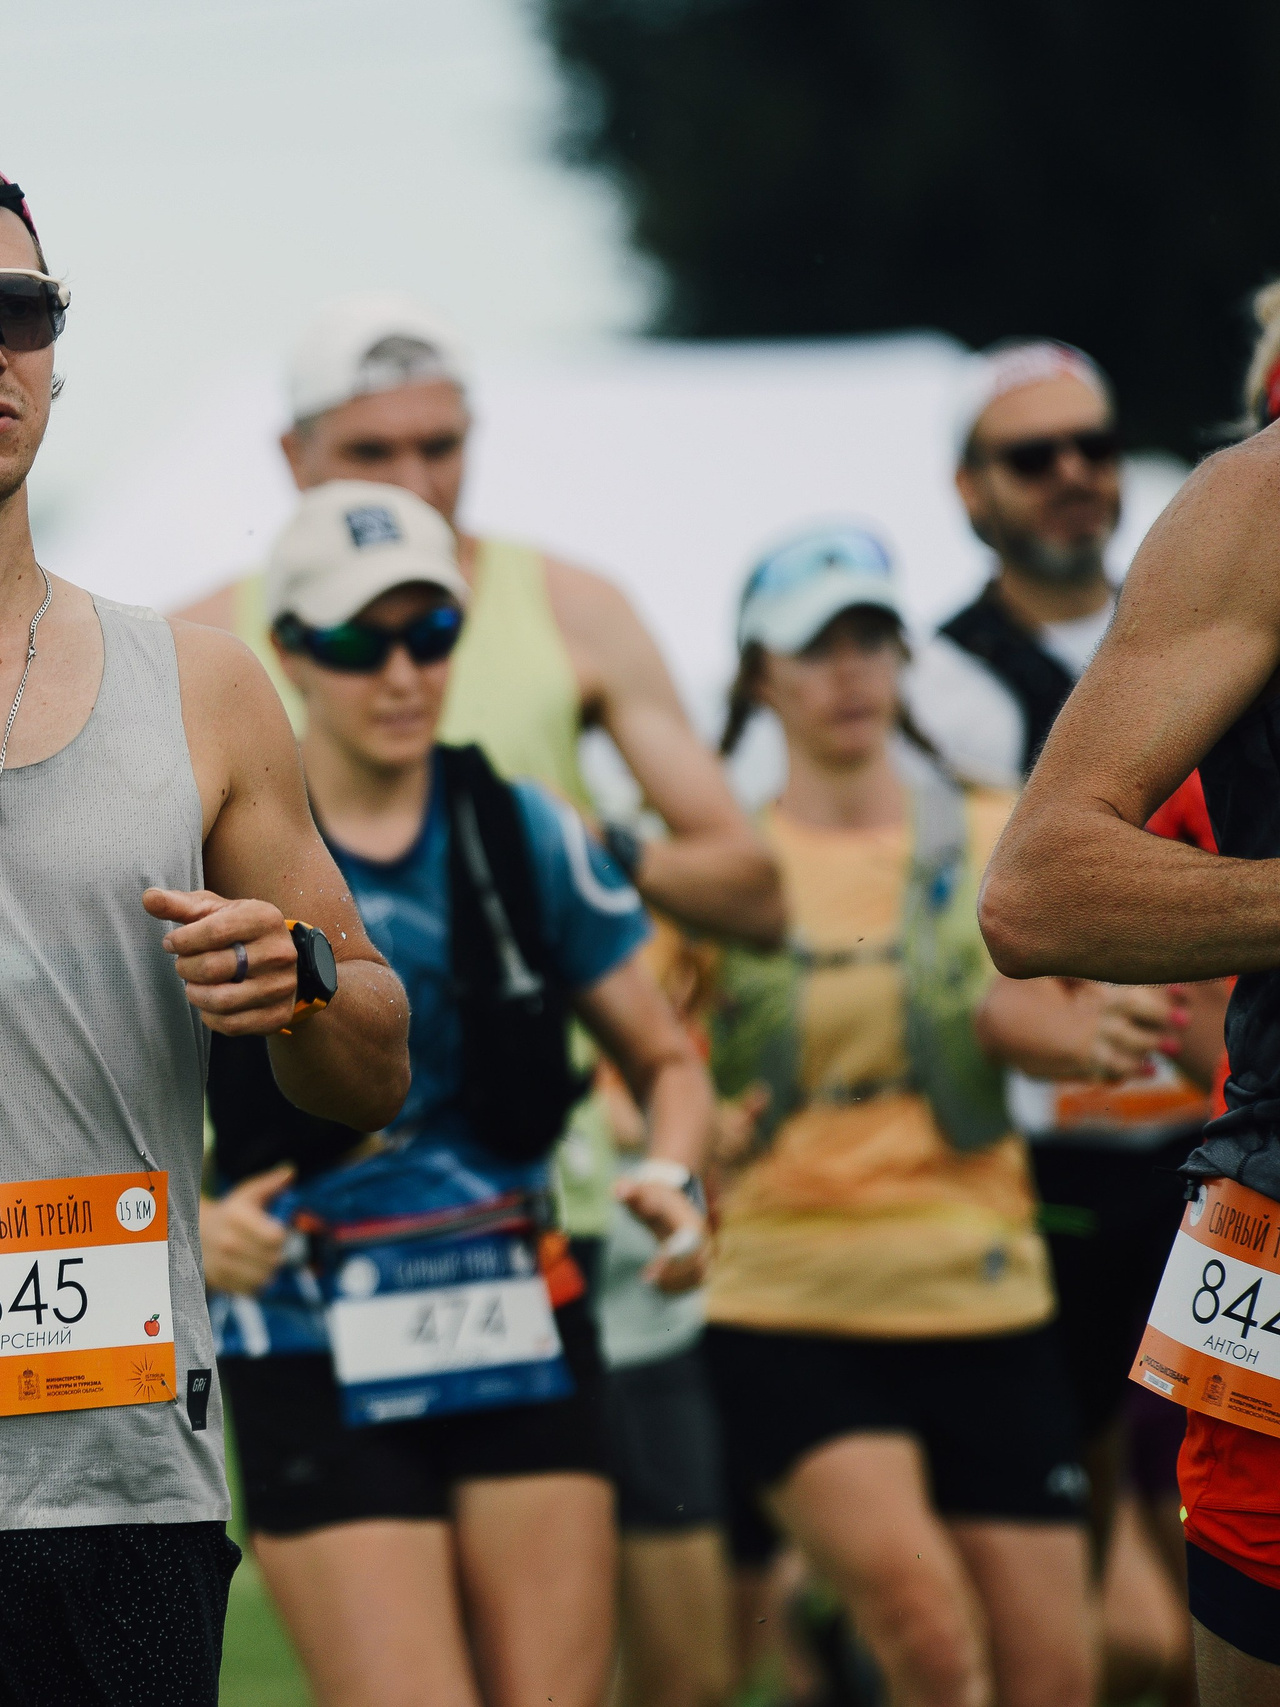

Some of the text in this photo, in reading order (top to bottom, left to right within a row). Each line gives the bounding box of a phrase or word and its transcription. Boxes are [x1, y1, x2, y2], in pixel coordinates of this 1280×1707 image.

[35, 1195, 93, 1237] ТРЕЙЛ
[119, 1201, 131, 1220] 15
[1208, 1202, 1271, 1253] СЫРНЫЙ
[407, 1293, 508, 1349] 474
[1203, 1334, 1260, 1365] АНТОН
